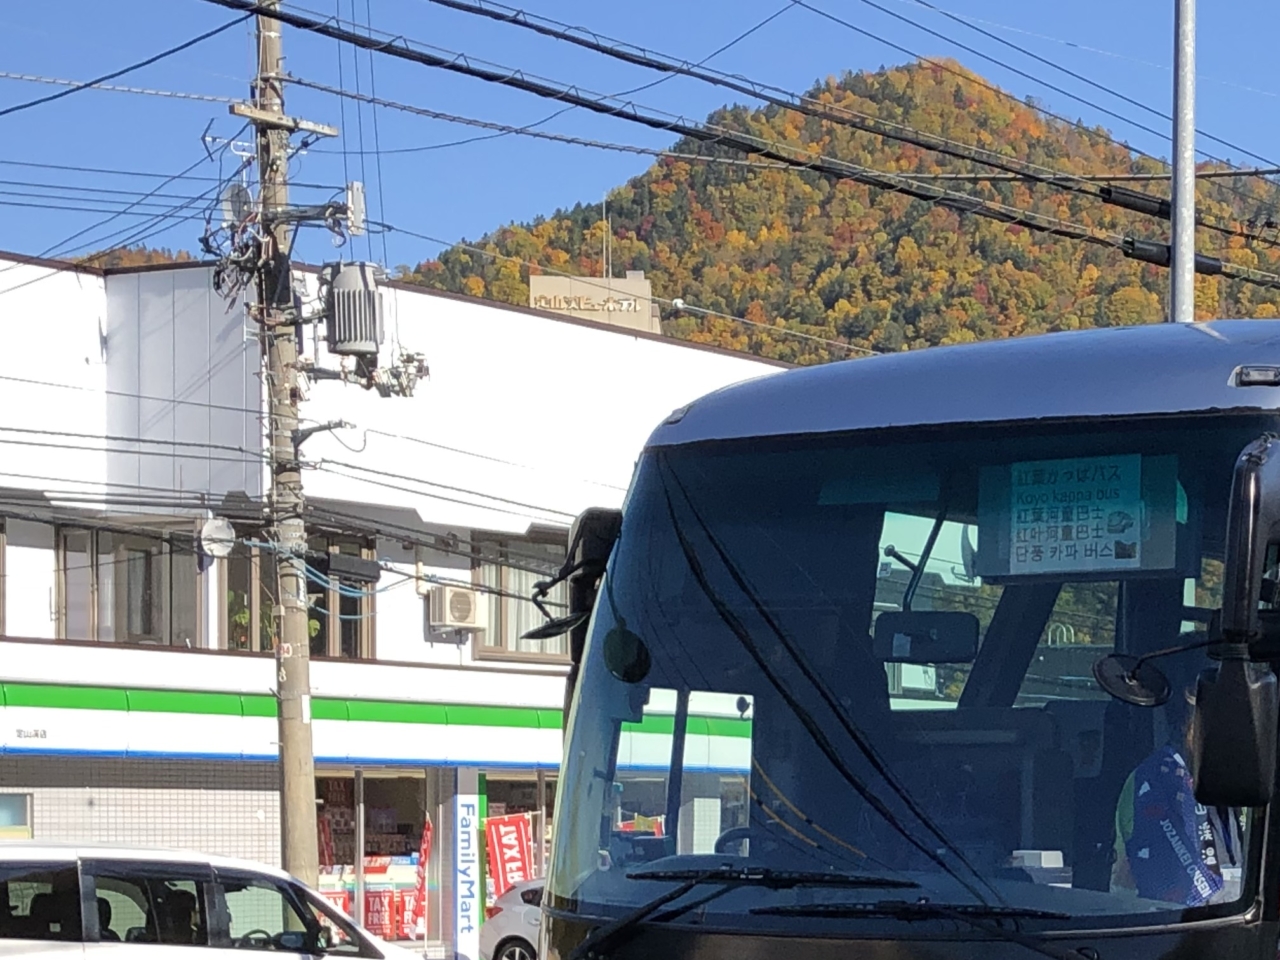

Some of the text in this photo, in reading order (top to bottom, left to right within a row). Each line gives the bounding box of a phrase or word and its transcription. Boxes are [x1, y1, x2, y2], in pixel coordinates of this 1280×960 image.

[1016, 486, 1121, 506] Koyo kappa bus
[1015, 542, 1113, 563] 단풍 카파 버스
[457, 803, 476, 933] FamilyMart
[368, 897, 390, 911] TAX
[368, 912, 390, 925] FREE
